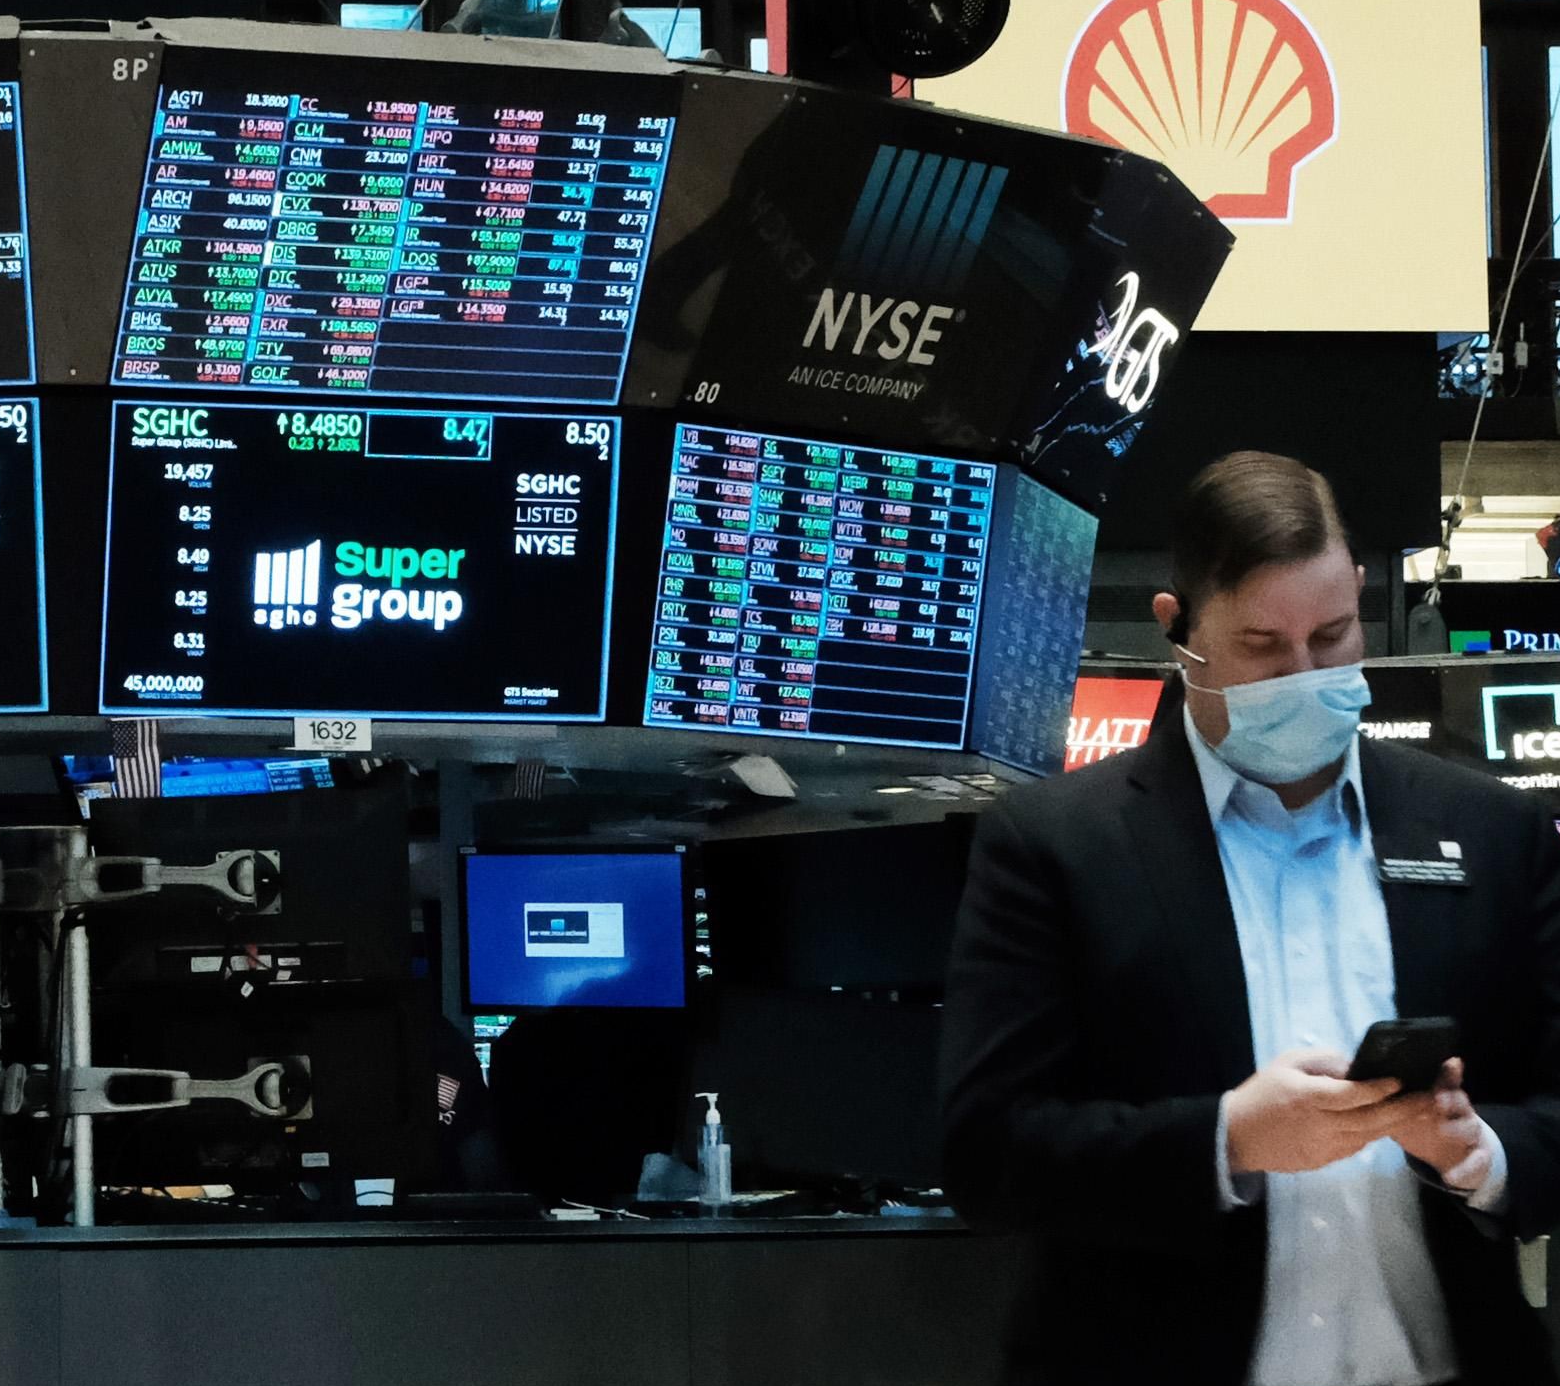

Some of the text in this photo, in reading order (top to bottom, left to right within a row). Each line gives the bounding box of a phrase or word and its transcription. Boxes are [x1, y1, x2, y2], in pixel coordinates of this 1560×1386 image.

[112, 57, 149, 81] 8P
[286, 171, 327, 186] COOK
[414, 179, 445, 192] HUN
[152, 189, 193, 205] ARCH
[277, 220, 317, 236] DBRG
[401, 251, 438, 265] LDOS
[138, 263, 177, 278] ATUS
[801, 288, 956, 368] NYSE
[1105, 307, 1179, 413] GTS
[251, 366, 290, 380] GOLF
[788, 365, 924, 400] AN ICE COMPANY
[132, 408, 209, 438] SGHC
[290, 412, 363, 438] 8.4850
[443, 419, 488, 443] 8.47
[565, 421, 612, 446] 8.50
[163, 463, 215, 482] 19,457
[515, 473, 582, 496] SGHC
[178, 505, 212, 523] 8.25
[515, 506, 578, 524] LISTED
[515, 534, 576, 557] NYSE
[177, 547, 210, 566] 8.49
[334, 541, 466, 588] Super
[174, 590, 208, 608] 8.25
[331, 583, 464, 631] group
[173, 632, 206, 650] 8.31
[123, 675, 204, 695] 45,000,000
[309, 721, 357, 740] 1632
